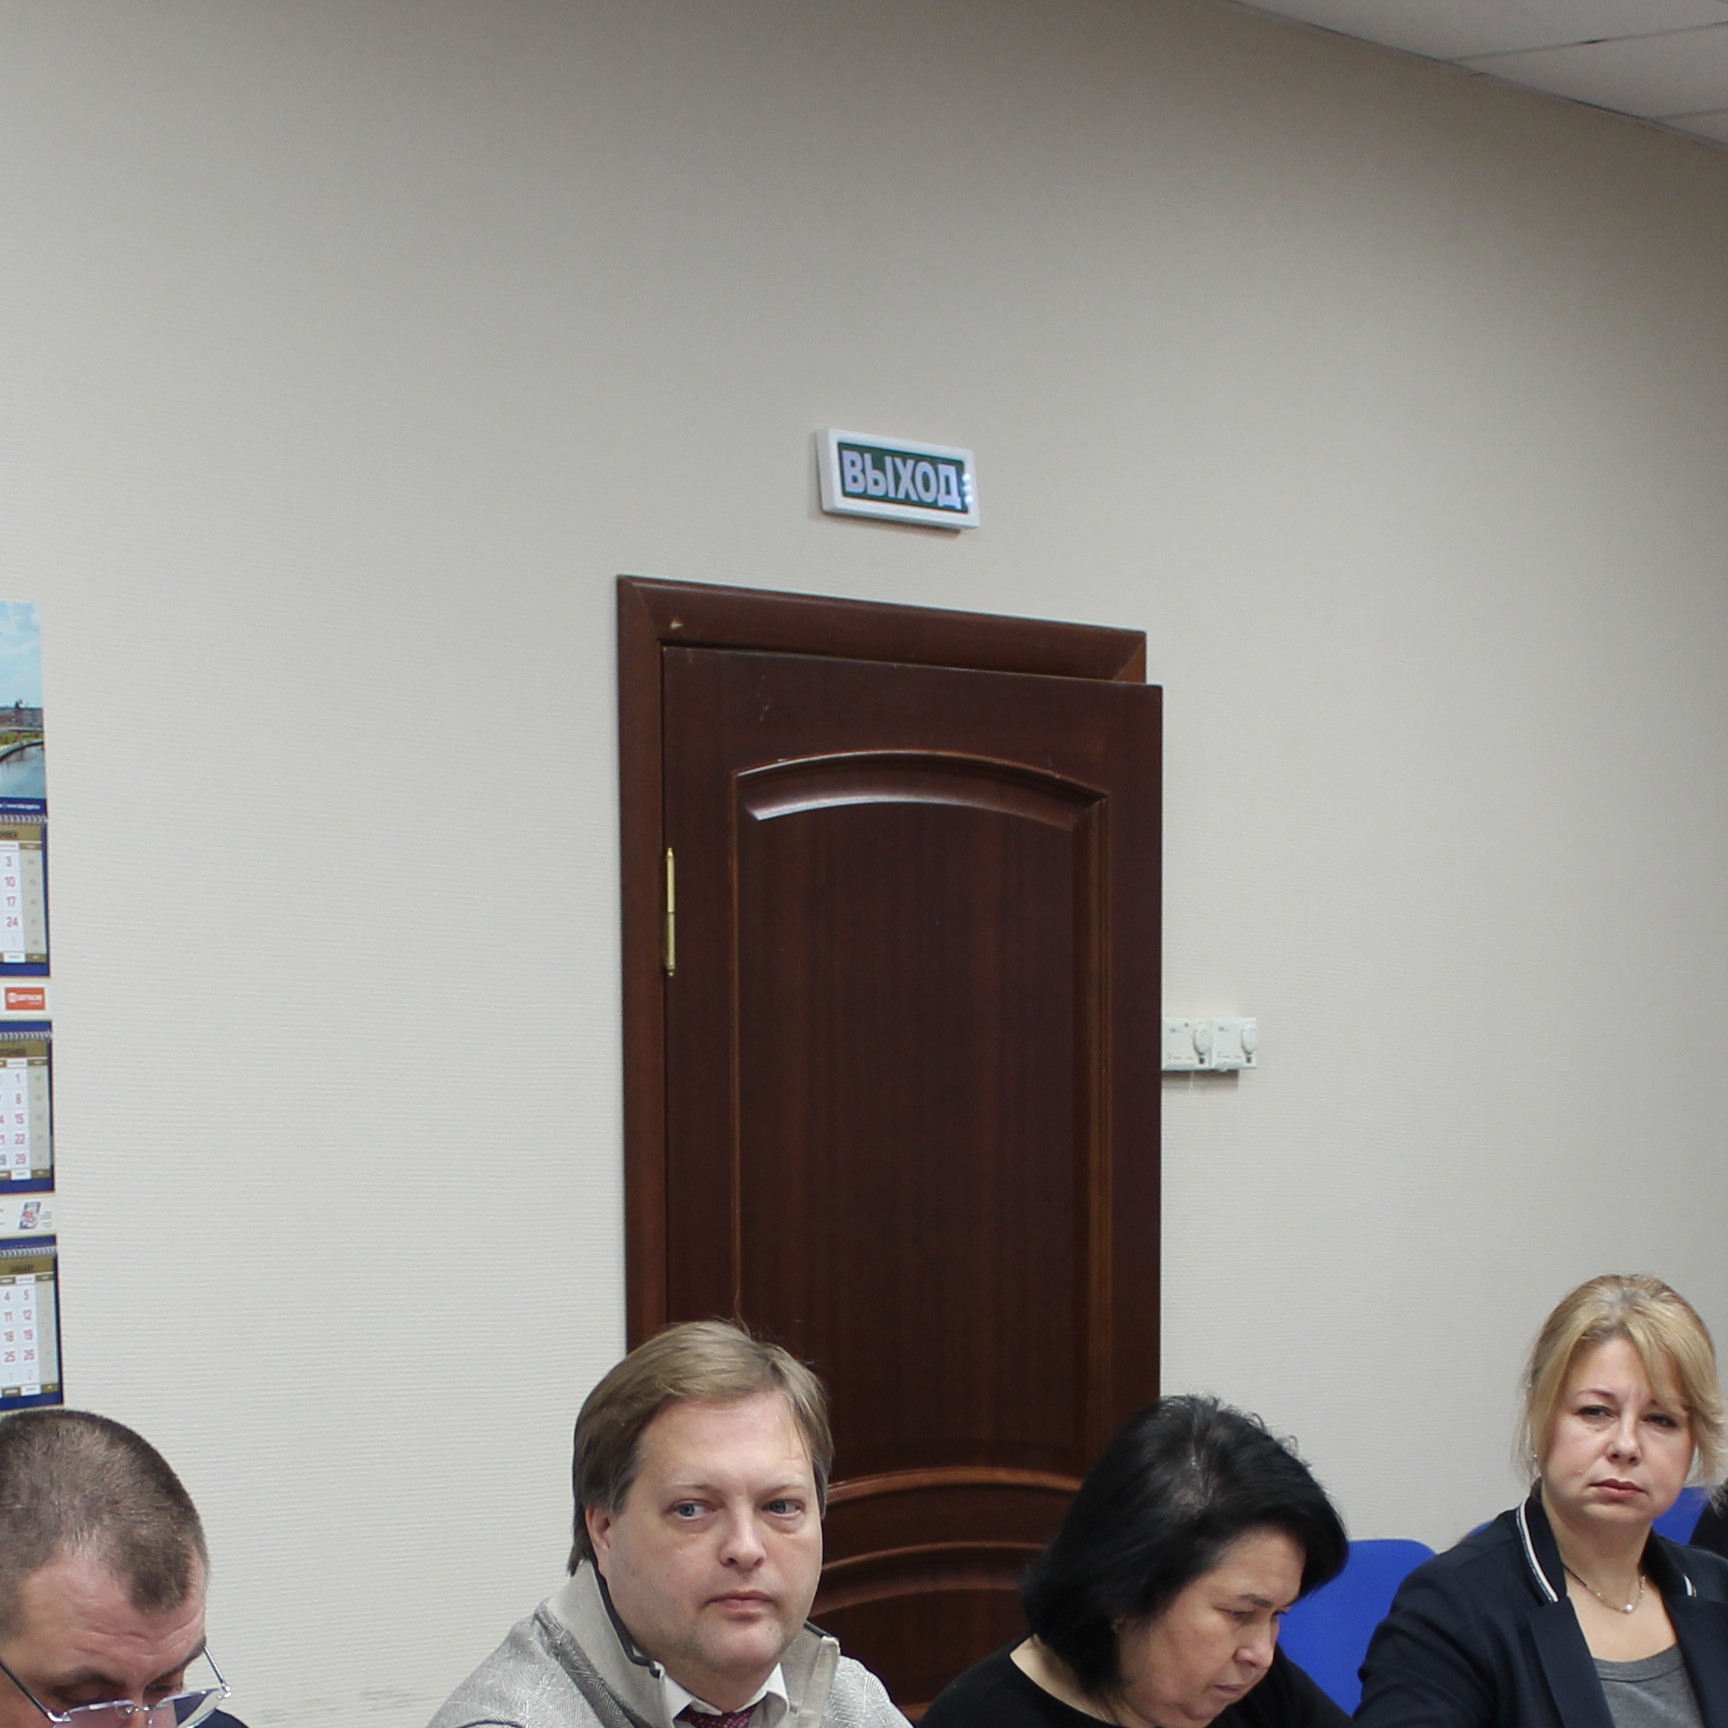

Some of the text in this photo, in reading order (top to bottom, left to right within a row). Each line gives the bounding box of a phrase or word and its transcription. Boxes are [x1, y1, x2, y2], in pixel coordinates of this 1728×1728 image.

[841, 449, 962, 510] ВЫХОД
[5, 856, 12, 867] 3
[4, 876, 16, 888] 10
[5, 896, 17, 907] 17
[6, 916, 19, 928] 24
[15, 1093, 22, 1105] 8
[13, 1113, 25, 1125] 15
[14, 1133, 25, 1145] 22
[15, 1153, 27, 1165] 29
[4, 1292, 11, 1301] 4
[23, 1289, 30, 1301] 5
[2, 1311, 14, 1322] 11
[21, 1309, 33, 1321] 12
[3, 1331, 15, 1342] 18
[22, 1329, 34, 1340] 19
[4, 1351, 16, 1363] 25
[22, 1349, 35, 1361] 26
